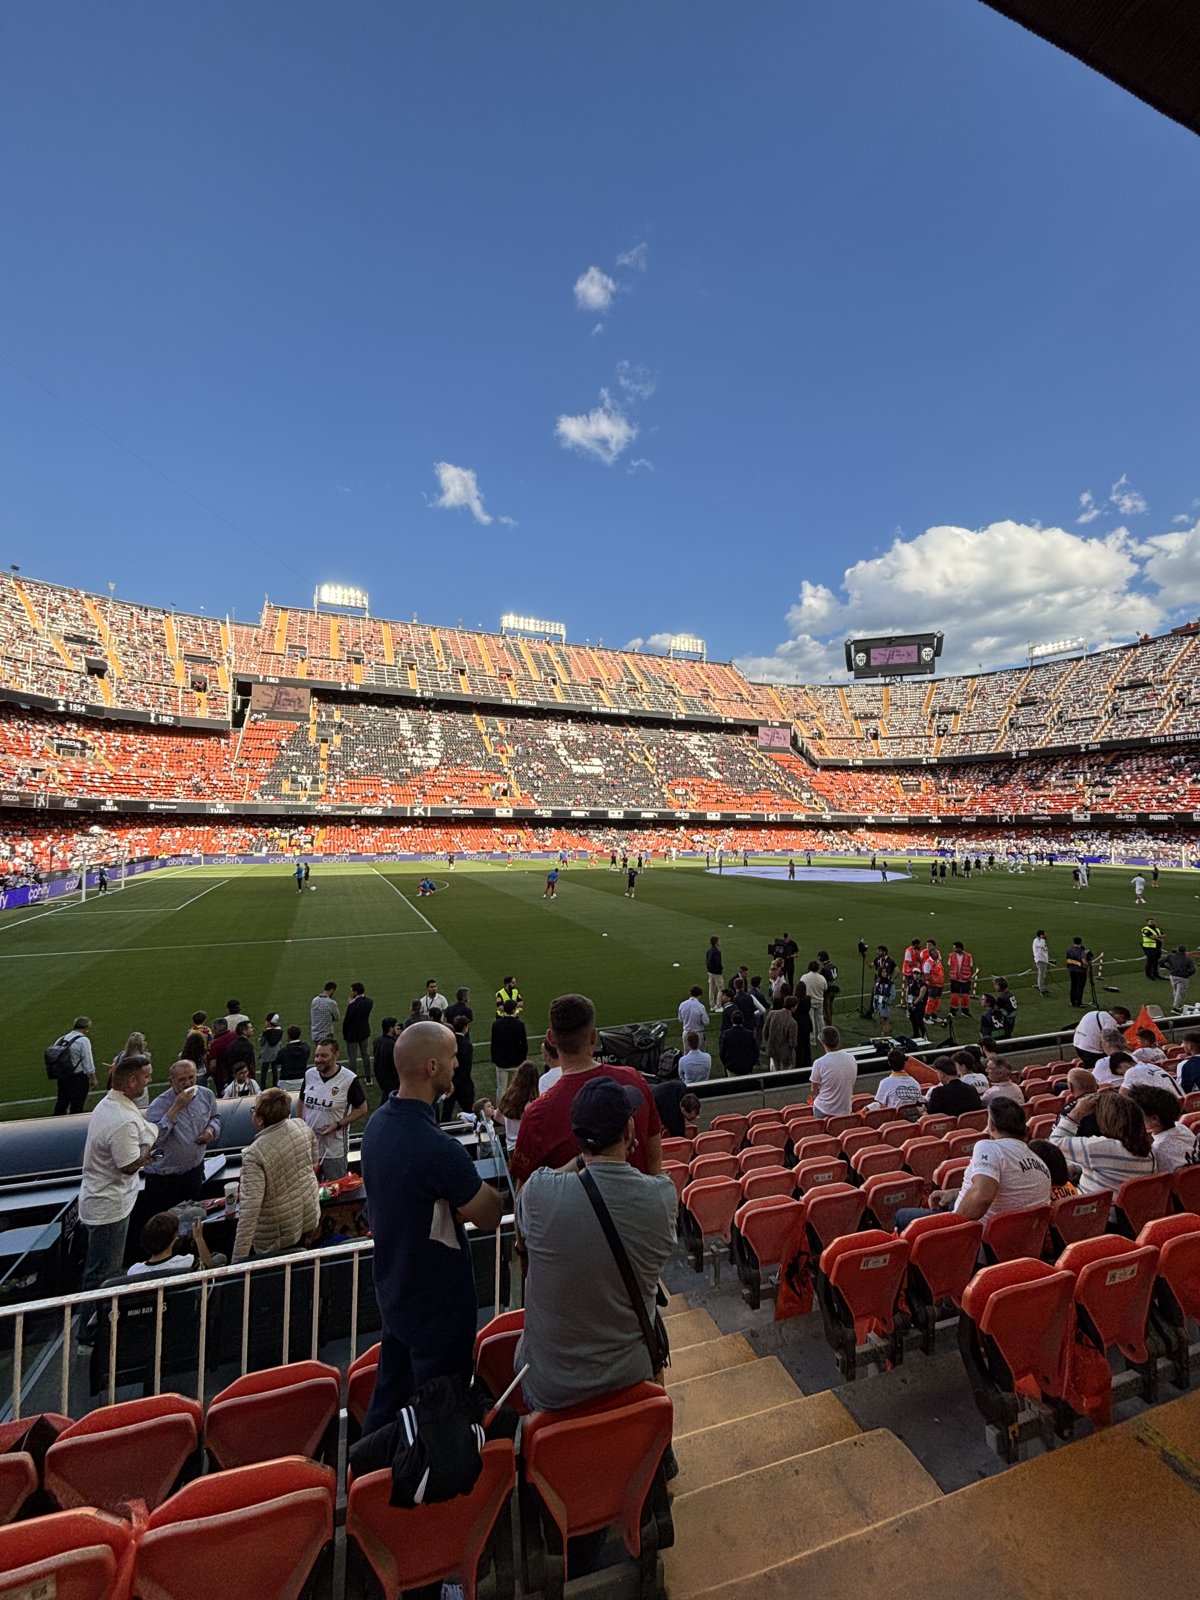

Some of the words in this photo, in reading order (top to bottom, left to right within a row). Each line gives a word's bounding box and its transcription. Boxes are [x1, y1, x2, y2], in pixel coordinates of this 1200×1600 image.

[69, 703, 86, 712] 1954
[158, 715, 175, 723] 1962
[1150, 736, 1165, 744] ESTO
[305, 1096, 334, 1108] BLU
